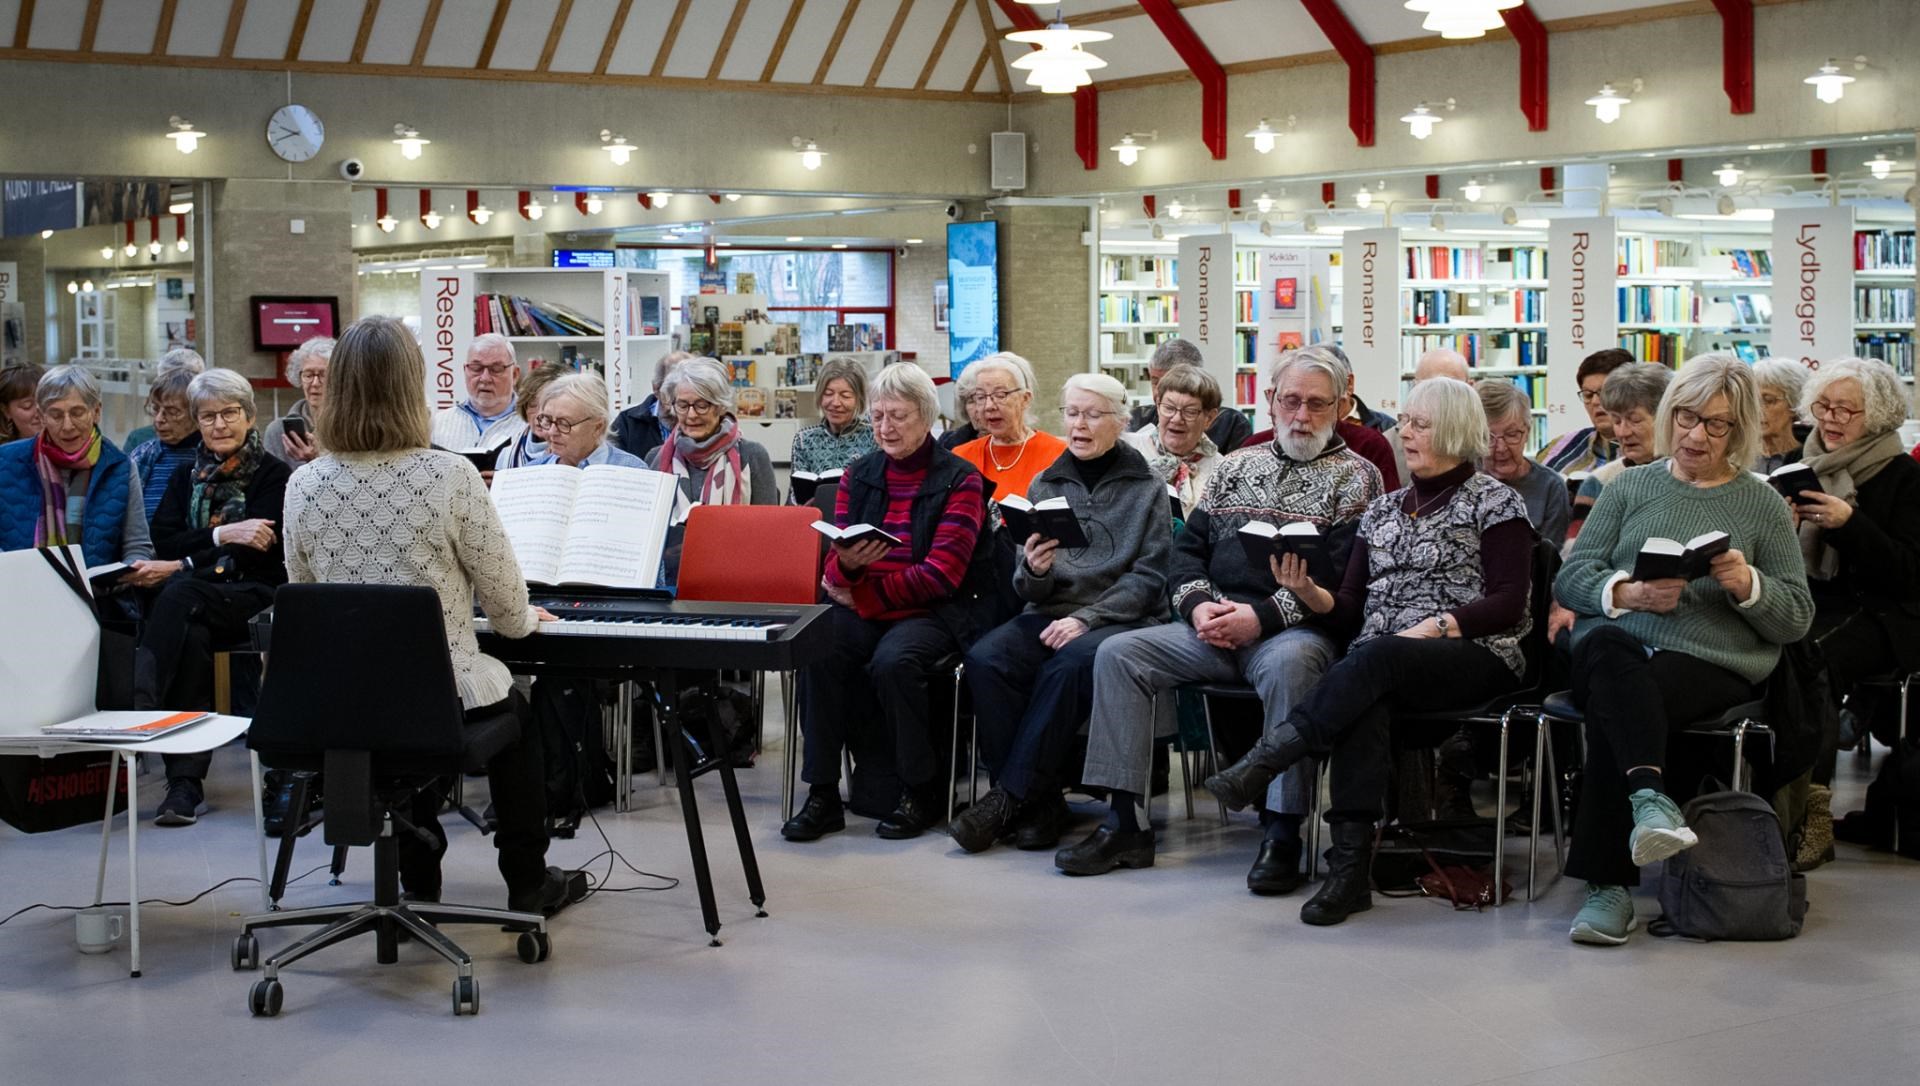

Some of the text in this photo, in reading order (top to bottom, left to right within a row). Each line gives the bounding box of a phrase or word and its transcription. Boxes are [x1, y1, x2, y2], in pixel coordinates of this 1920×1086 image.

[1198, 246, 1212, 345] Romaner
[1363, 241, 1378, 348] Romaner
[1571, 232, 1590, 350] Romaner
[1795, 223, 1821, 347] Lydbøger
